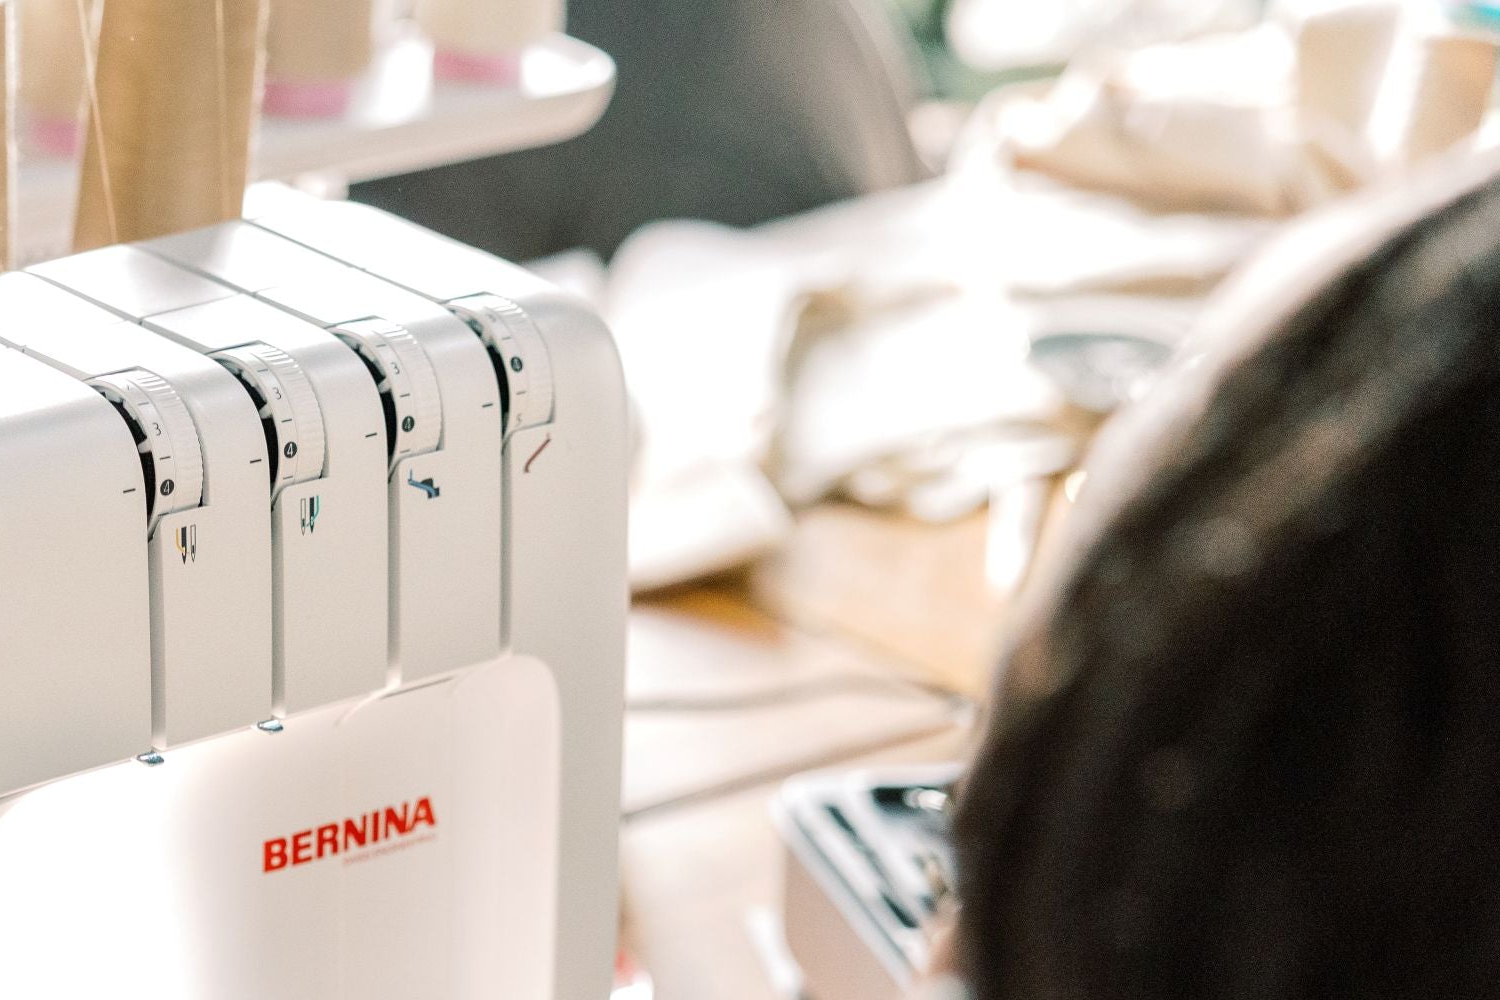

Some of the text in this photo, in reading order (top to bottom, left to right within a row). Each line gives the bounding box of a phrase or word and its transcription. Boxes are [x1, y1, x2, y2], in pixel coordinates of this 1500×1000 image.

[390, 361, 400, 375] 3
[272, 387, 282, 400] 3
[152, 422, 162, 437] 3
[263, 795, 437, 873] BERNINA
